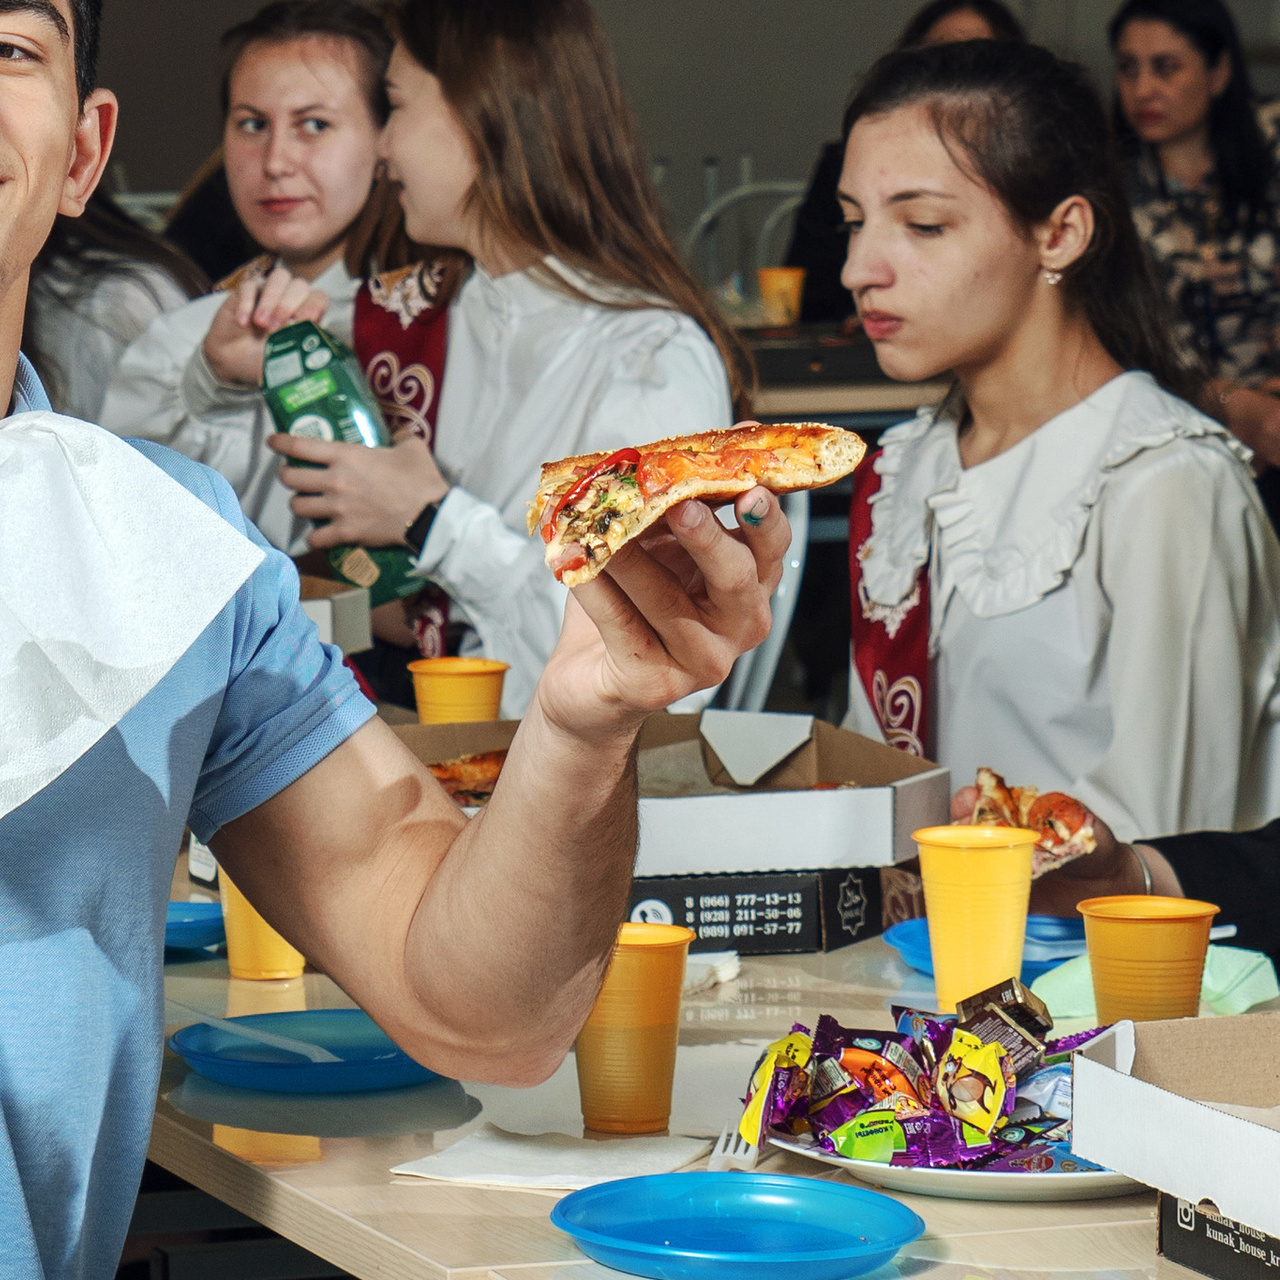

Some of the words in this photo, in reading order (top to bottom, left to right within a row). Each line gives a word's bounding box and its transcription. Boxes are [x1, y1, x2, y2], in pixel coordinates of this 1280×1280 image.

[685, 896, 695, 909] 8
[700, 894, 730, 909] (966)
[735, 892, 802, 907] 777-13-13
[685, 911, 695, 924] 8
[1206, 1214, 1266, 1242] nak_house
[1206, 1223, 1280, 1267] kunak_house_kr
